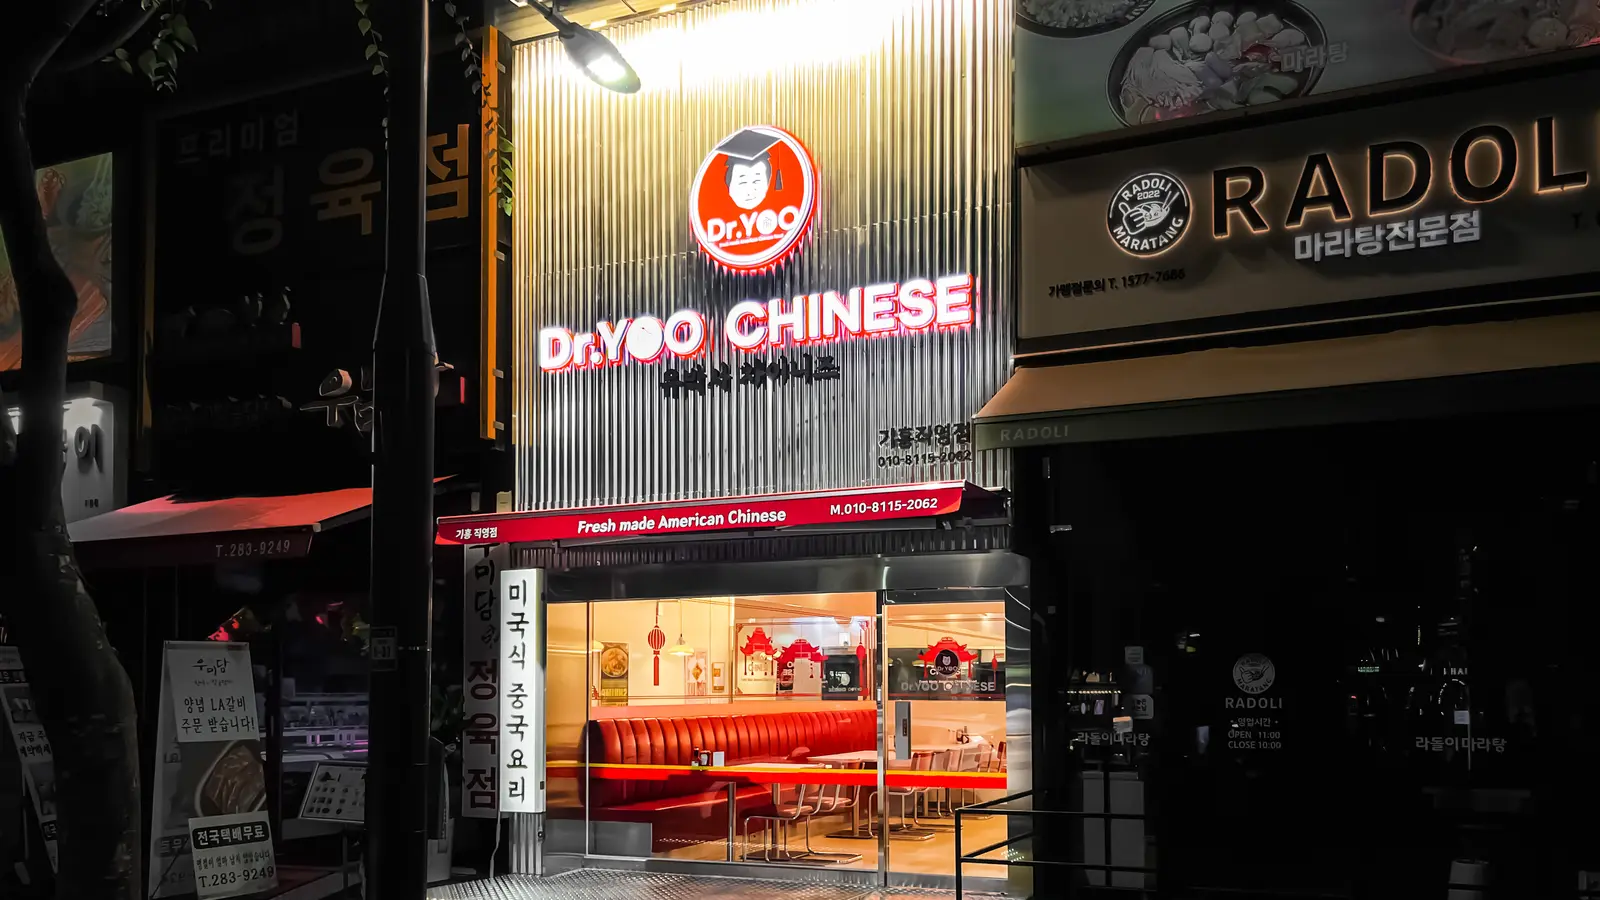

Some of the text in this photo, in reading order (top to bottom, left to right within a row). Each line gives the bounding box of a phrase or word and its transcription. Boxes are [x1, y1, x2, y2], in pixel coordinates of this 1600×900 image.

[1281, 41, 1348, 72] 마라탕
[174, 106, 300, 165] 프리미엄
[1212, 116, 1590, 239] RADOL
[223, 123, 470, 256] 정육점
[1121, 178, 1172, 201] RADOLI
[1136, 189, 1161, 200] 2022
[707, 205, 800, 243] Dr.YOO
[1113, 217, 1184, 250] MARATANG
[1294, 210, 1481, 262] 마라탕전문점
[1107, 277, 1119, 290] T.
[540, 273, 973, 371] Dr.YOO CHINESE
[660, 353, 840, 399] 유박사 차이니즈
[878, 422, 971, 449] 기흥직영점
[1001, 425, 1069, 441] RADOLI
[878, 450, 972, 468] 010-8115-2062
[830, 498, 938, 515] M.010-8115-2062
[577, 508, 787, 534] Fresh made American Chinese
[455, 526, 498, 540] 기흥 직영점
[506, 579, 530, 803] 미국식 중국요리
[184, 696, 246, 713] 양념 LA갈비
[1225, 697, 1282, 709] RADOLI
[181, 716, 255, 734] 주문 받습니다!
[1238, 717, 1271, 727] 영업시간
[466, 658, 501, 809] 정육점
[1077, 732, 1151, 746] 라돌이마라탕
[1228, 730, 1281, 739] OPEN 11:00
[1228, 740, 1282, 749] CLOSE 10:00
[1416, 736, 1507, 753] 라돌이마라탕
